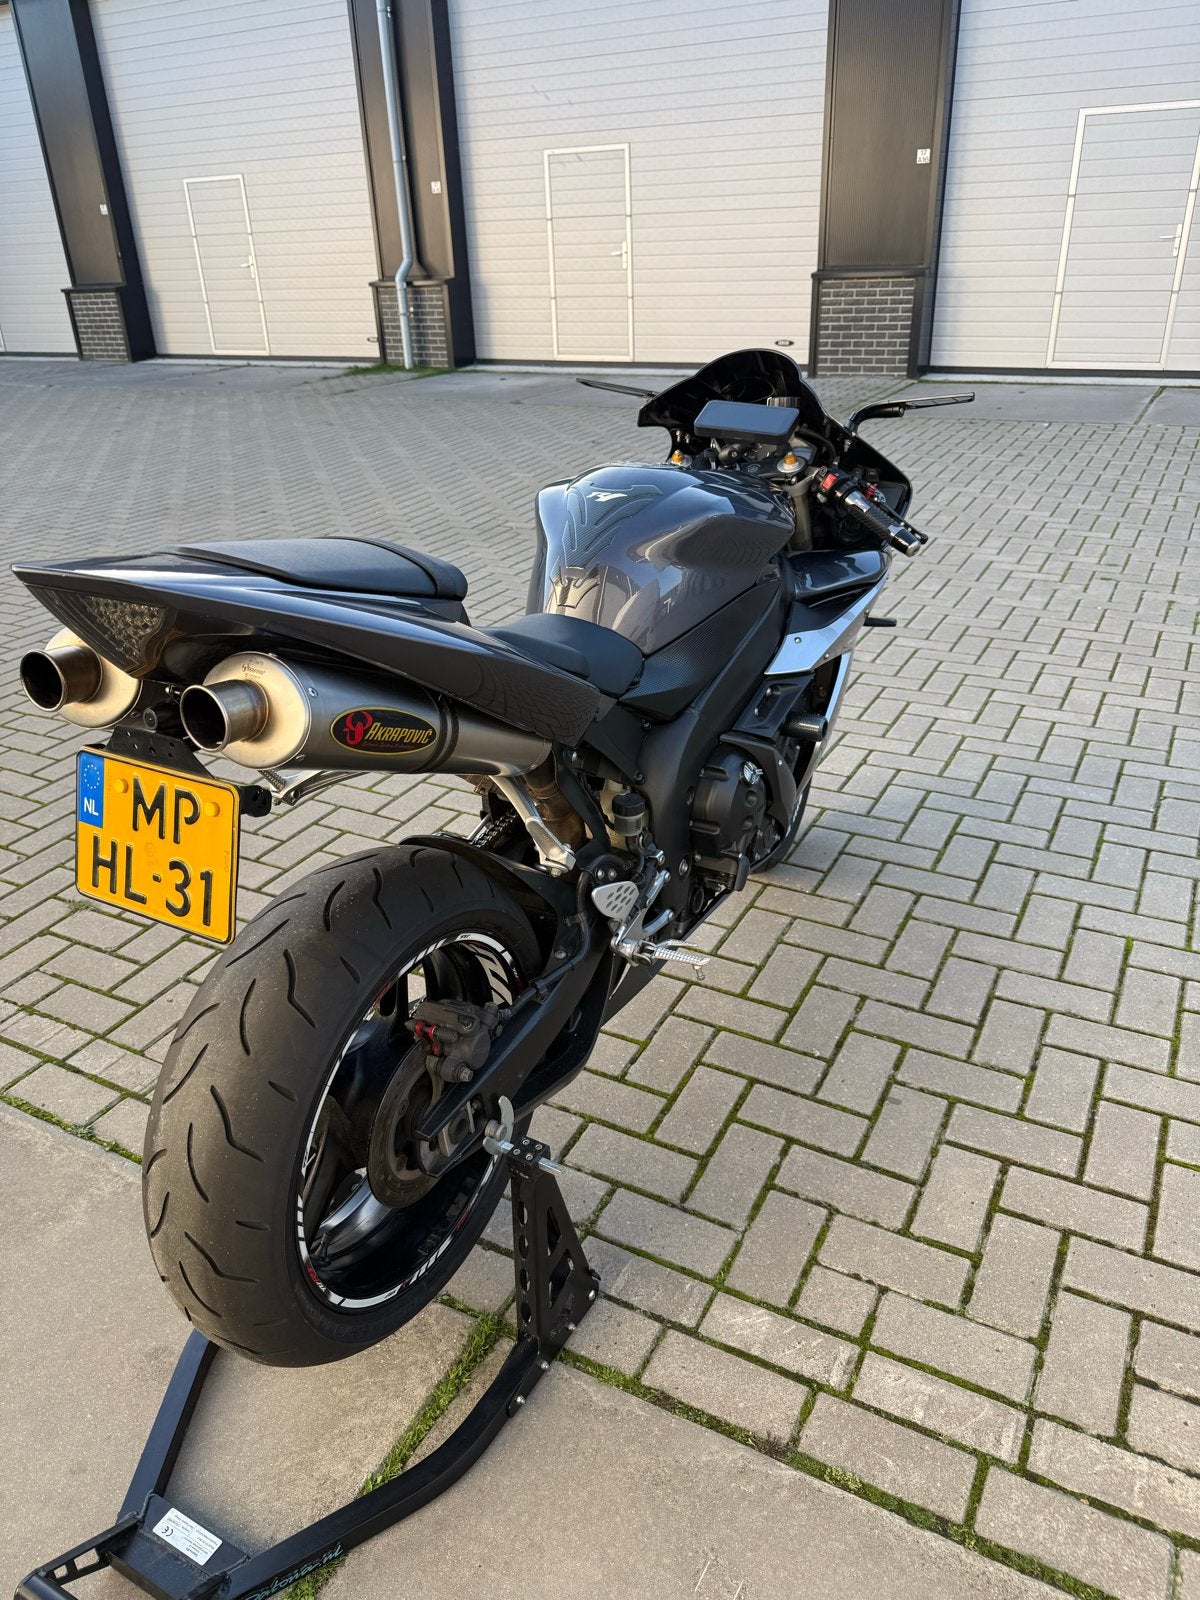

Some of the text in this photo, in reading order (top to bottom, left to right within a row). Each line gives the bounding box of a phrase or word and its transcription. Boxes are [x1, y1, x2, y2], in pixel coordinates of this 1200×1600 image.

[83, 796, 99, 816] NL
[132, 775, 201, 845] MP
[91, 833, 213, 927] HL-31
